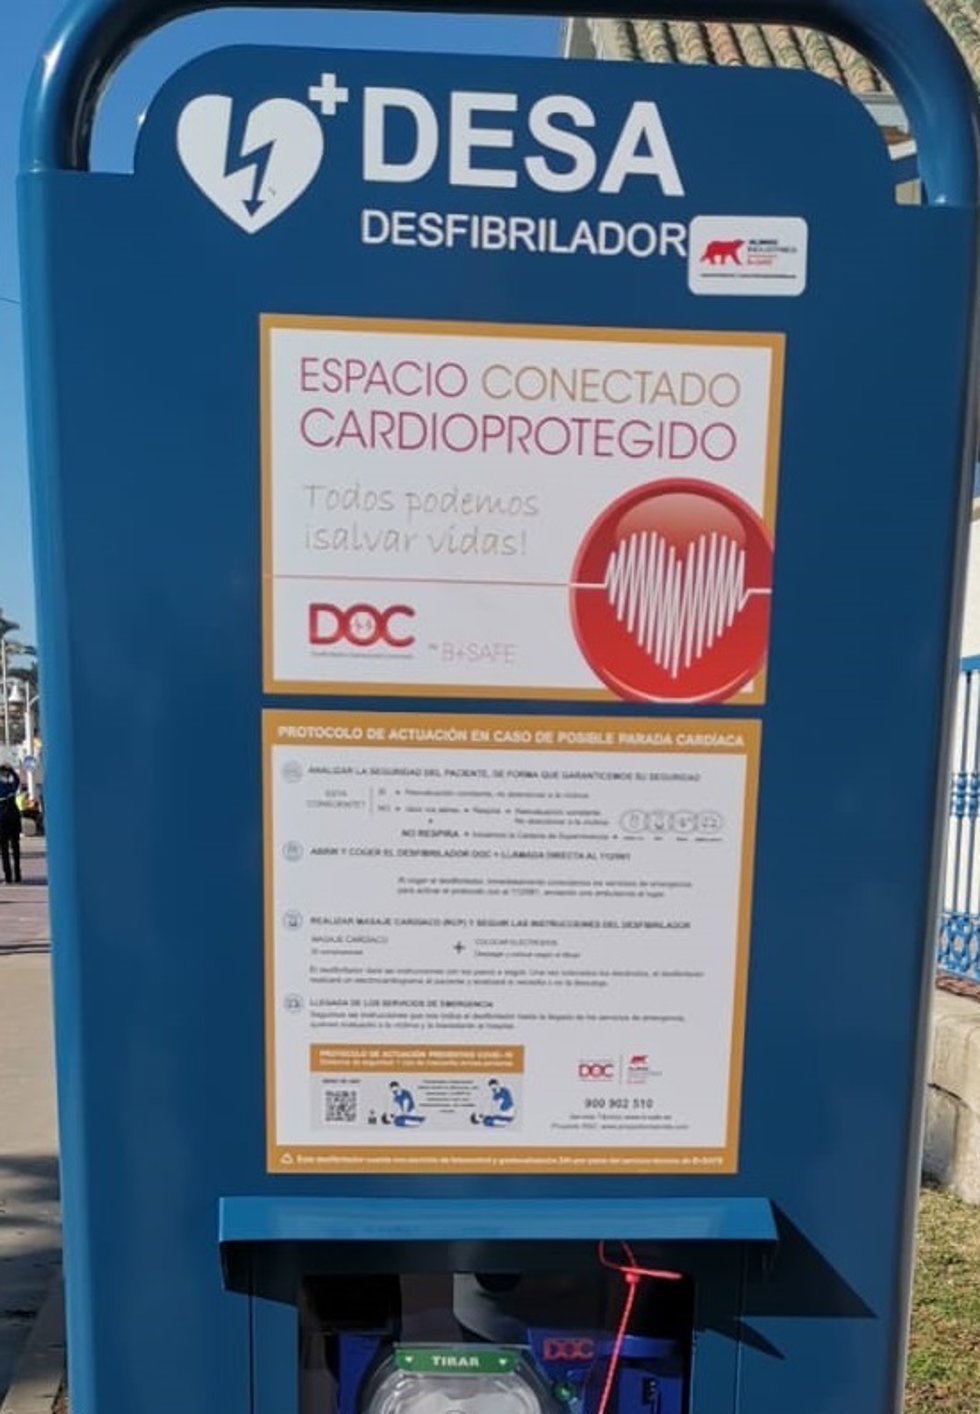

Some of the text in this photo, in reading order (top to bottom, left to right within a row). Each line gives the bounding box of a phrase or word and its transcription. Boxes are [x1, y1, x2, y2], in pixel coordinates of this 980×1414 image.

[363, 86, 684, 197] DESA
[361, 208, 687, 257] DESFIBRILADOR
[300, 356, 742, 408] ESPACIO CONECTADO
[300, 407, 738, 462] CARDIOPROTEGIDO
[305, 481, 541, 523] Todos podemos
[427, 526, 527, 556] vidas!
[308, 602, 416, 648] DOC
[277, 725, 745, 747] PROTOCOLO DE ACTUACIÓN EN CASO DE POSIBLE PARADA CARDÍACA
[578, 1063, 614, 1078] DOC
[431, 1355, 480, 1367] TIRAR
[542, 1338, 596, 1360] DOC
